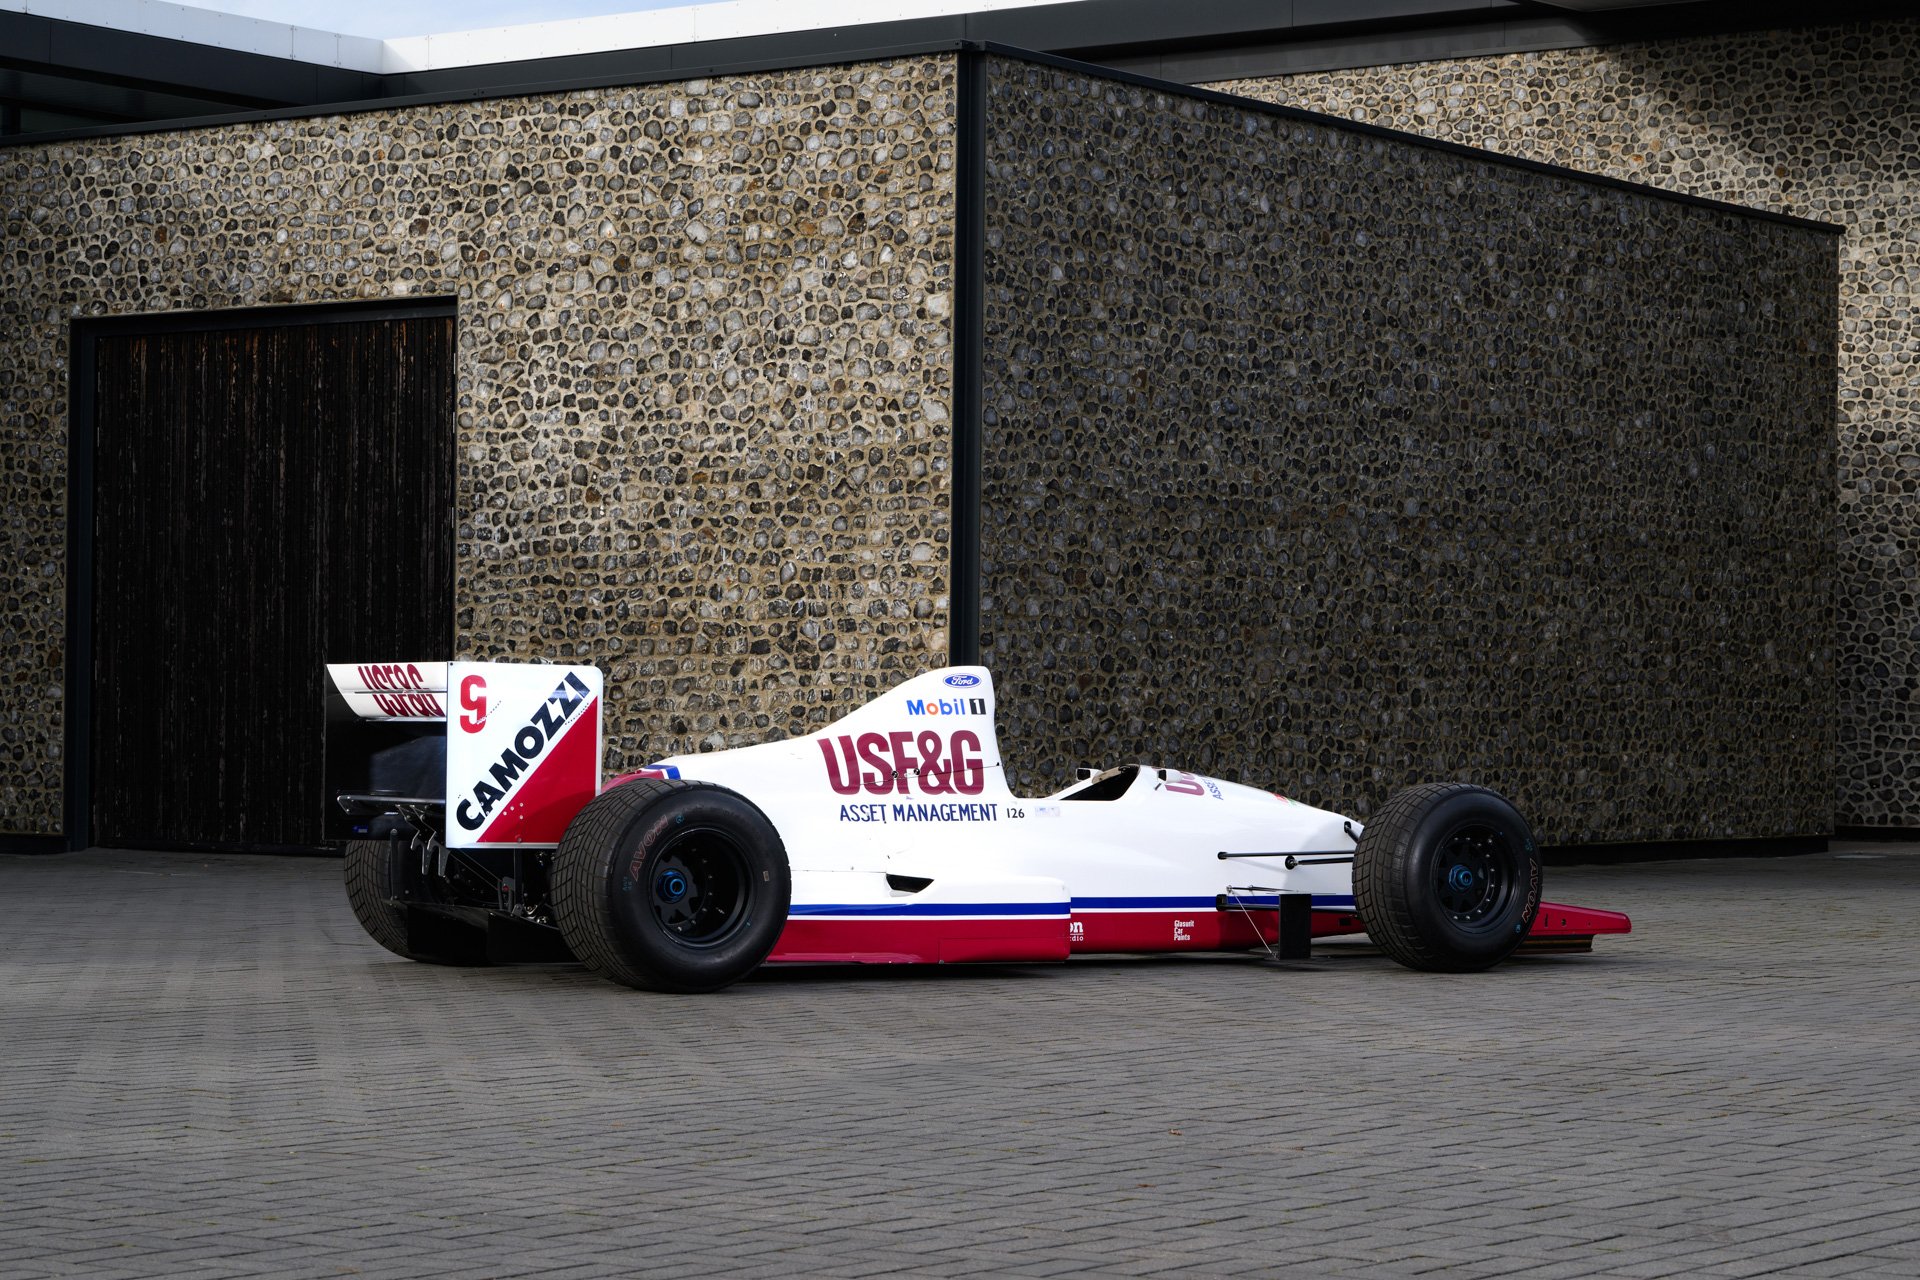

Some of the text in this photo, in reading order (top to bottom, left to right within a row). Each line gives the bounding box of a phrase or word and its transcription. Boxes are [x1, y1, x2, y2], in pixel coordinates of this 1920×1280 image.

[460, 674, 487, 734] 9
[906, 698, 966, 716] Mobil
[950, 675, 975, 686] Ford
[456, 671, 591, 831] CAMOZZI
[816, 730, 985, 796] USF&G
[839, 803, 998, 822] ASSET MANAGEMENT
[1006, 807, 1025, 819] 126
[629, 814, 669, 882] AVON
[1522, 857, 1539, 923] AVON
